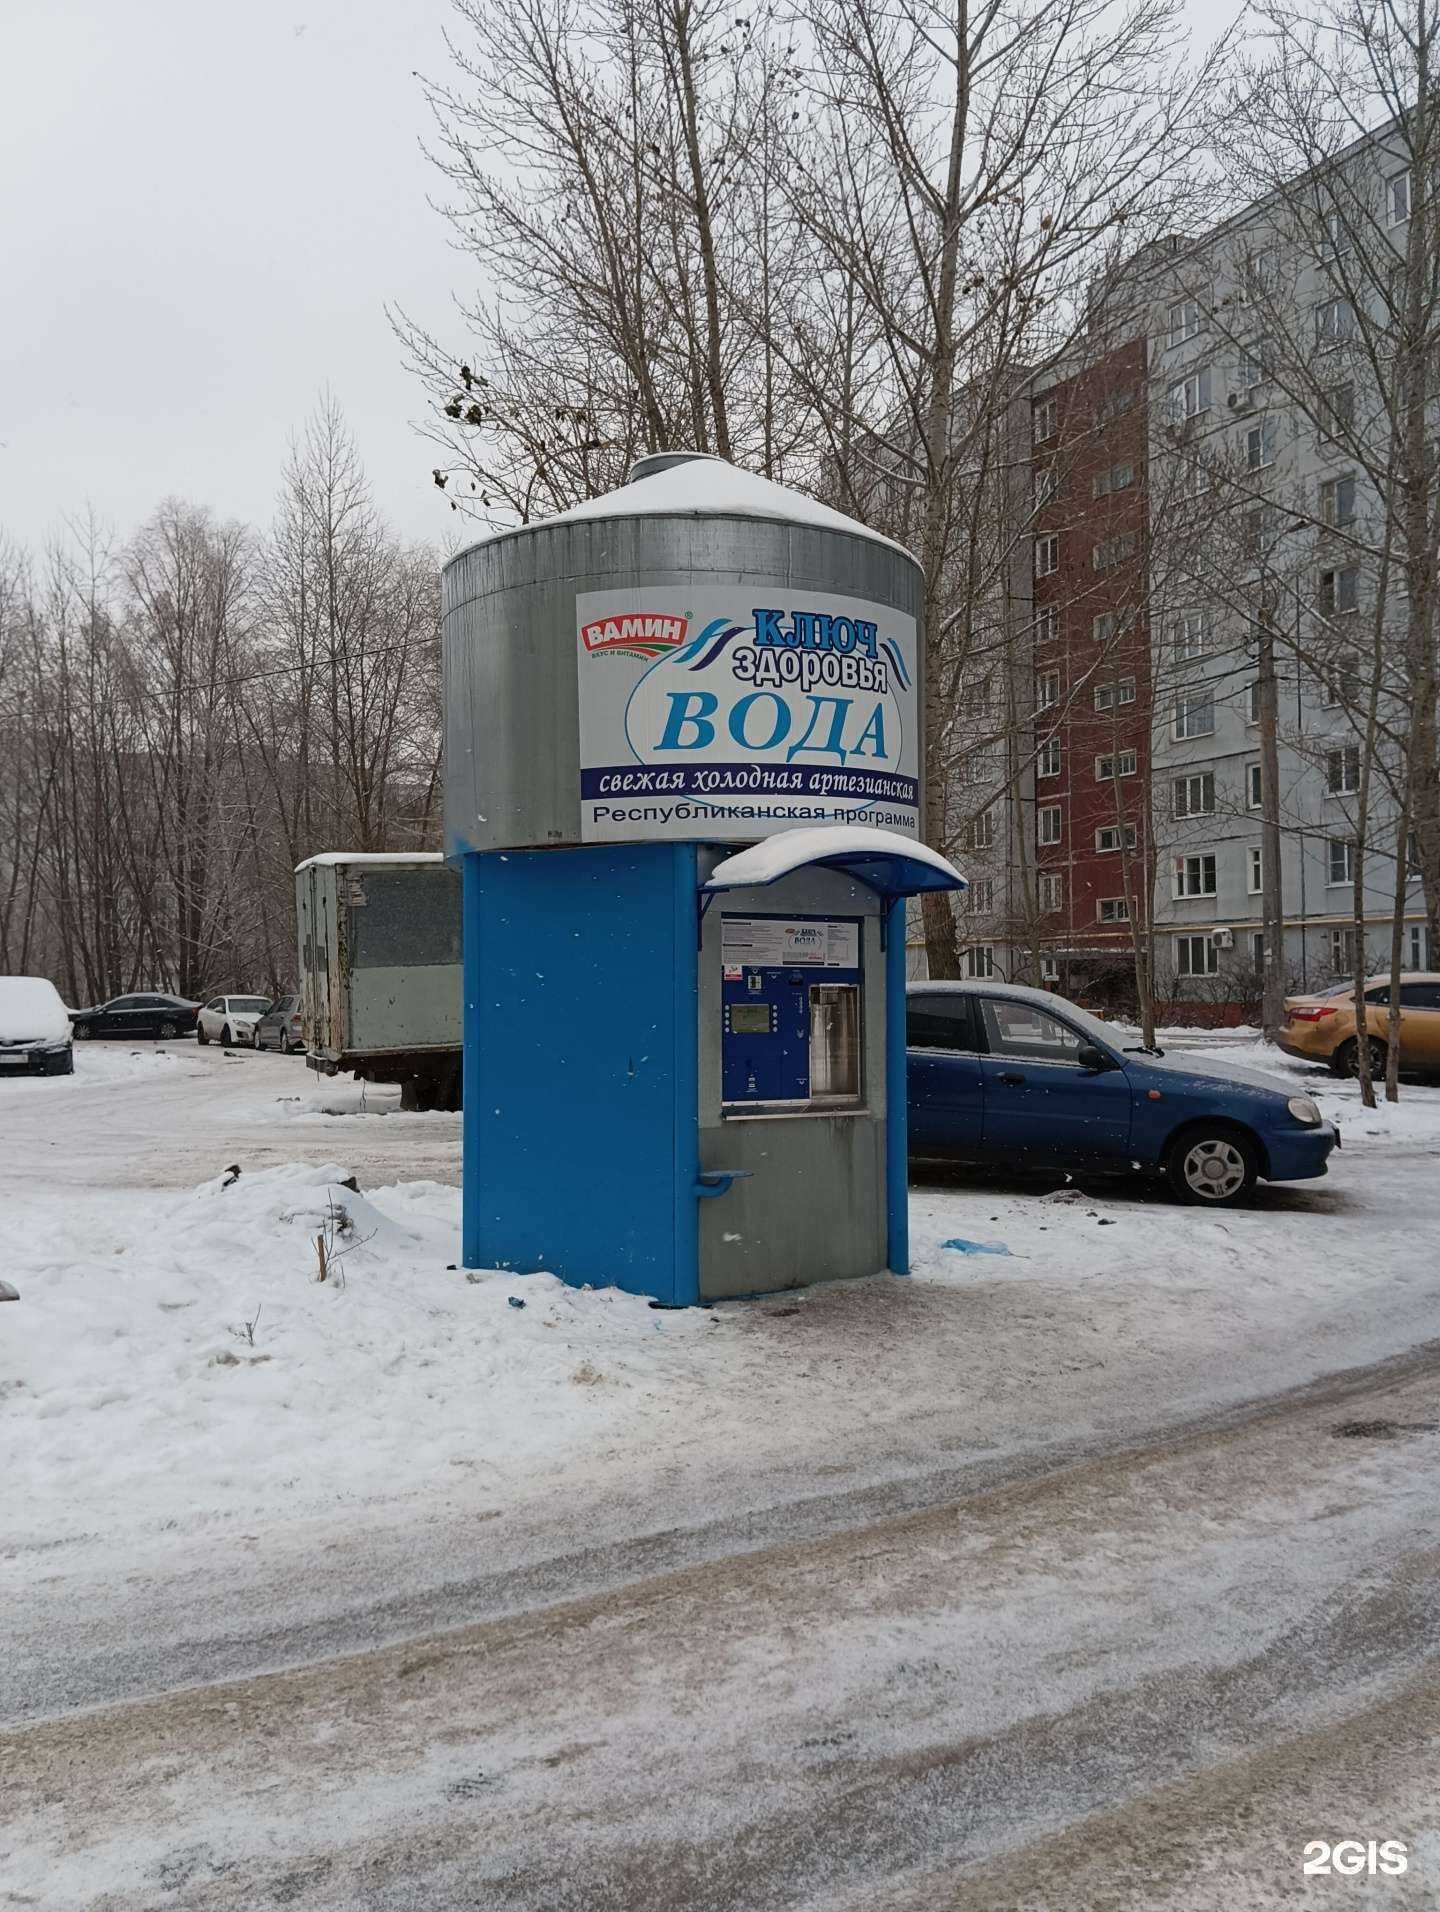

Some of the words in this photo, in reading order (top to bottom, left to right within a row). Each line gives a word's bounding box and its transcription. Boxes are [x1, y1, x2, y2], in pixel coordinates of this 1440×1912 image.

[586, 618, 682, 646] ВАМИН
[752, 608, 879, 659] КЛЮЧ
[653, 691, 889, 766] ВОДА
[599, 770, 685, 792] свежая
[690, 764, 804, 791] холодная
[809, 772, 914, 800] артезианская
[593, 802, 826, 824] Республиканская
[833, 807, 916, 829] программа
